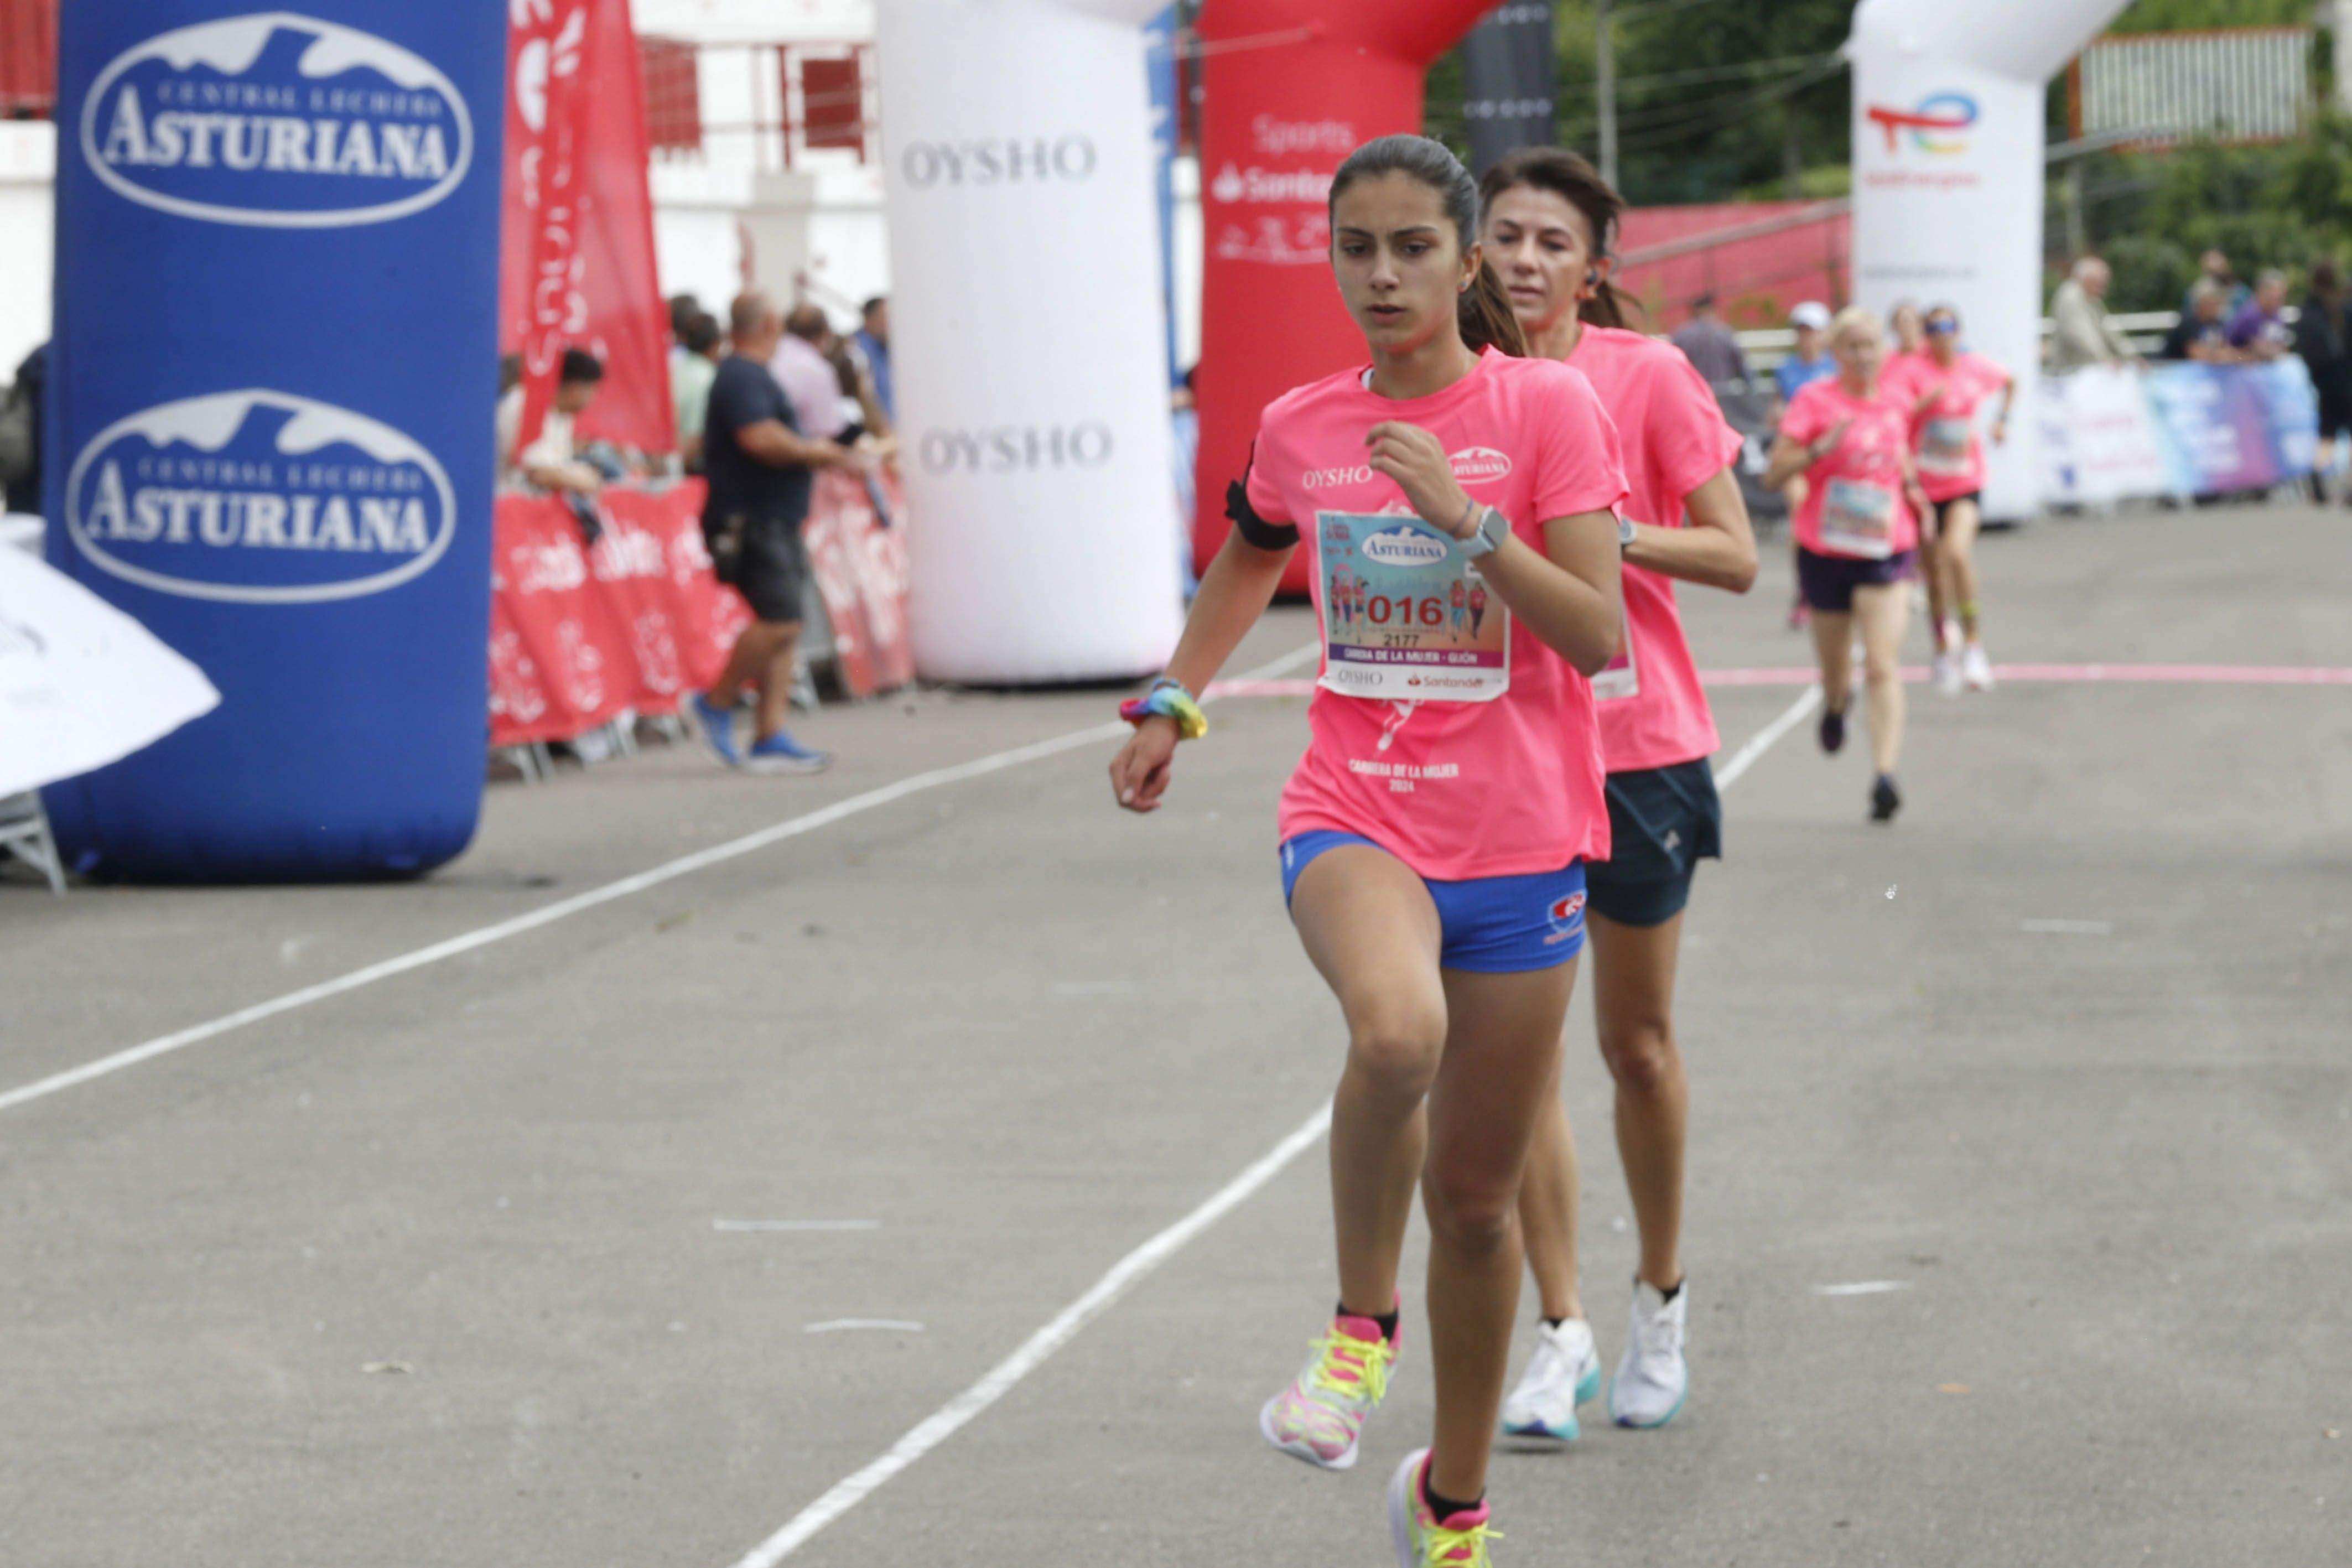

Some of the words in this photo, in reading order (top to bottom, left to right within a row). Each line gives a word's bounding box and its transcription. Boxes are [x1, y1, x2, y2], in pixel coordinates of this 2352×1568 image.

[102, 83, 448, 179] ASTURIANA
[901, 133, 1097, 190] OYSHO
[918, 419, 1114, 477] OYSHO
[1302, 465, 1373, 491] OYSHO
[1452, 463, 1505, 476] STURIANA
[86, 459, 431, 554] ASTURIANA
[1367, 539, 1442, 558] ASTURIANA
[1368, 595, 1444, 626] 016
[1384, 633, 1420, 647] 2177
[1390, 651, 1404, 662] LA
[1424, 676, 1485, 688] Santander
[1408, 765, 1421, 778] LA
